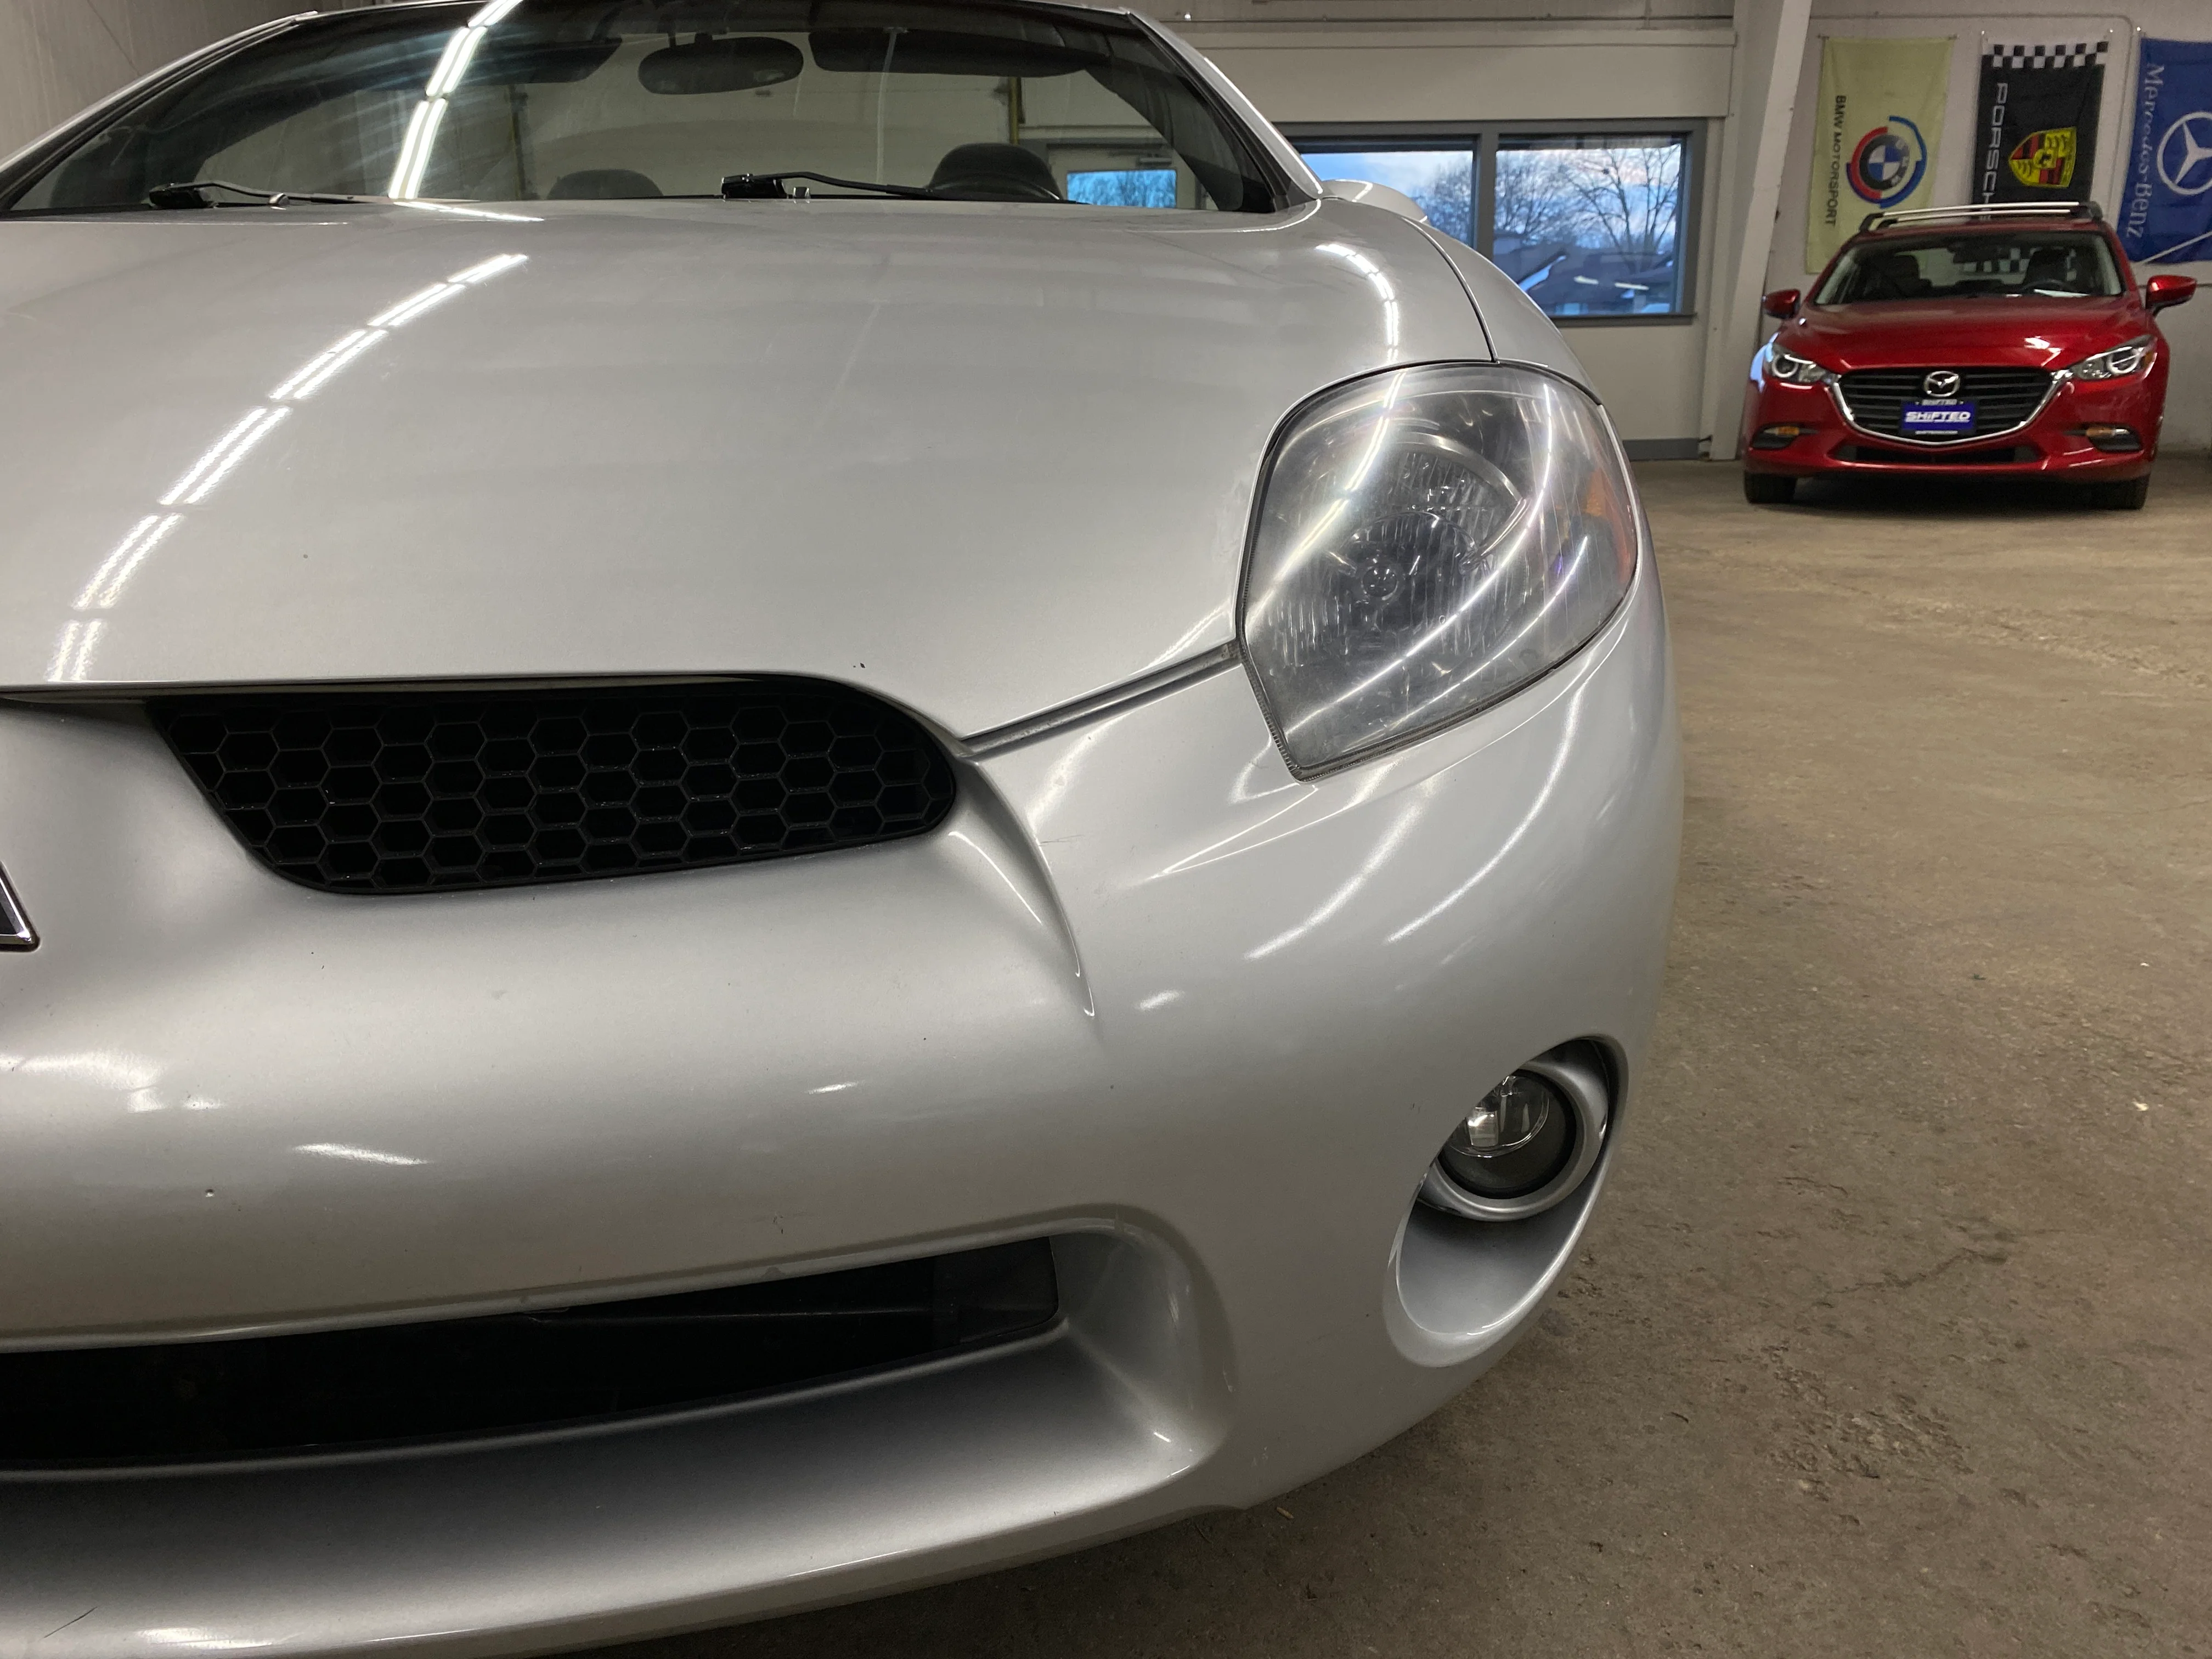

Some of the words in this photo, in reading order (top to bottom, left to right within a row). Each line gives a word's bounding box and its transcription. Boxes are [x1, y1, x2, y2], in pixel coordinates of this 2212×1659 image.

[1833, 95, 1847, 128] BMW
[2126, 63, 2165, 238] Mercedes-Benz
[1825, 132, 1842, 226] MOTORSPORT
